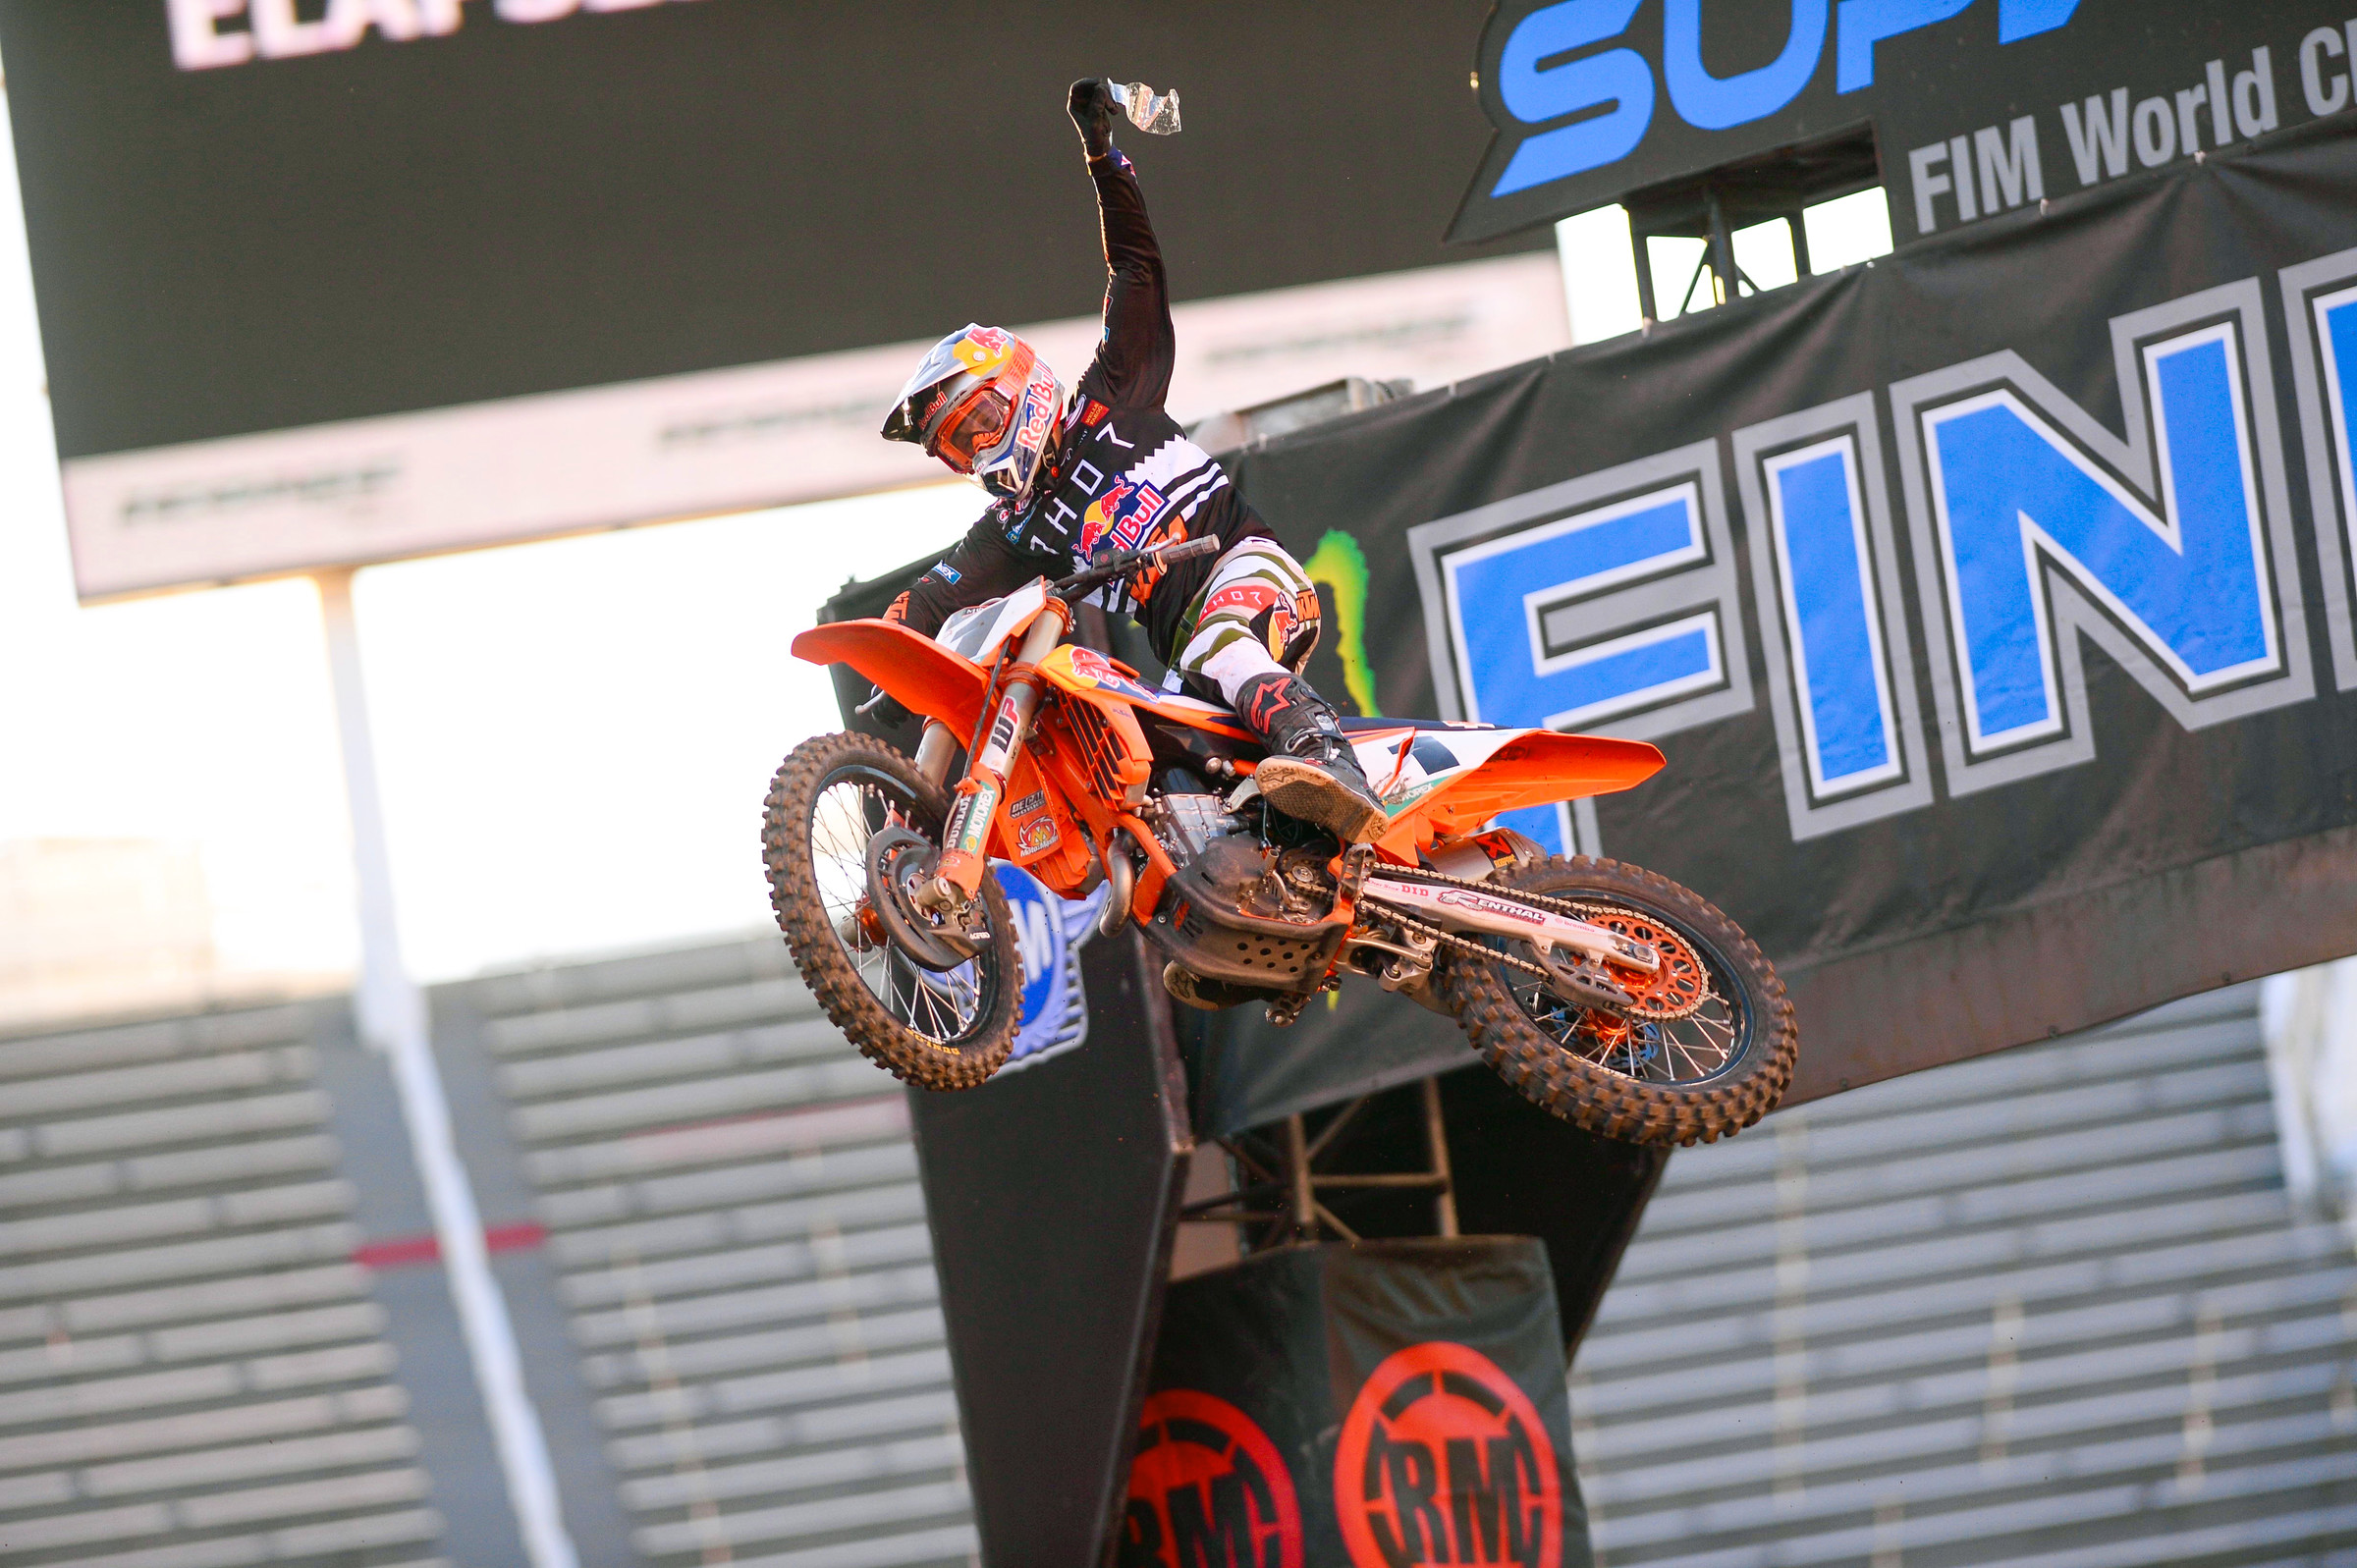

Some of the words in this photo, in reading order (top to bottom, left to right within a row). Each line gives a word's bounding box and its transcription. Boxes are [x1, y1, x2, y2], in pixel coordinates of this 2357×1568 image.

[1908, 116, 2046, 234] FIM
[2059, 45, 2279, 188] World
[1296, 589, 1320, 622] KTM
[966, 786, 996, 838] MOTOREX
[1400, 885, 1429, 897] DID
